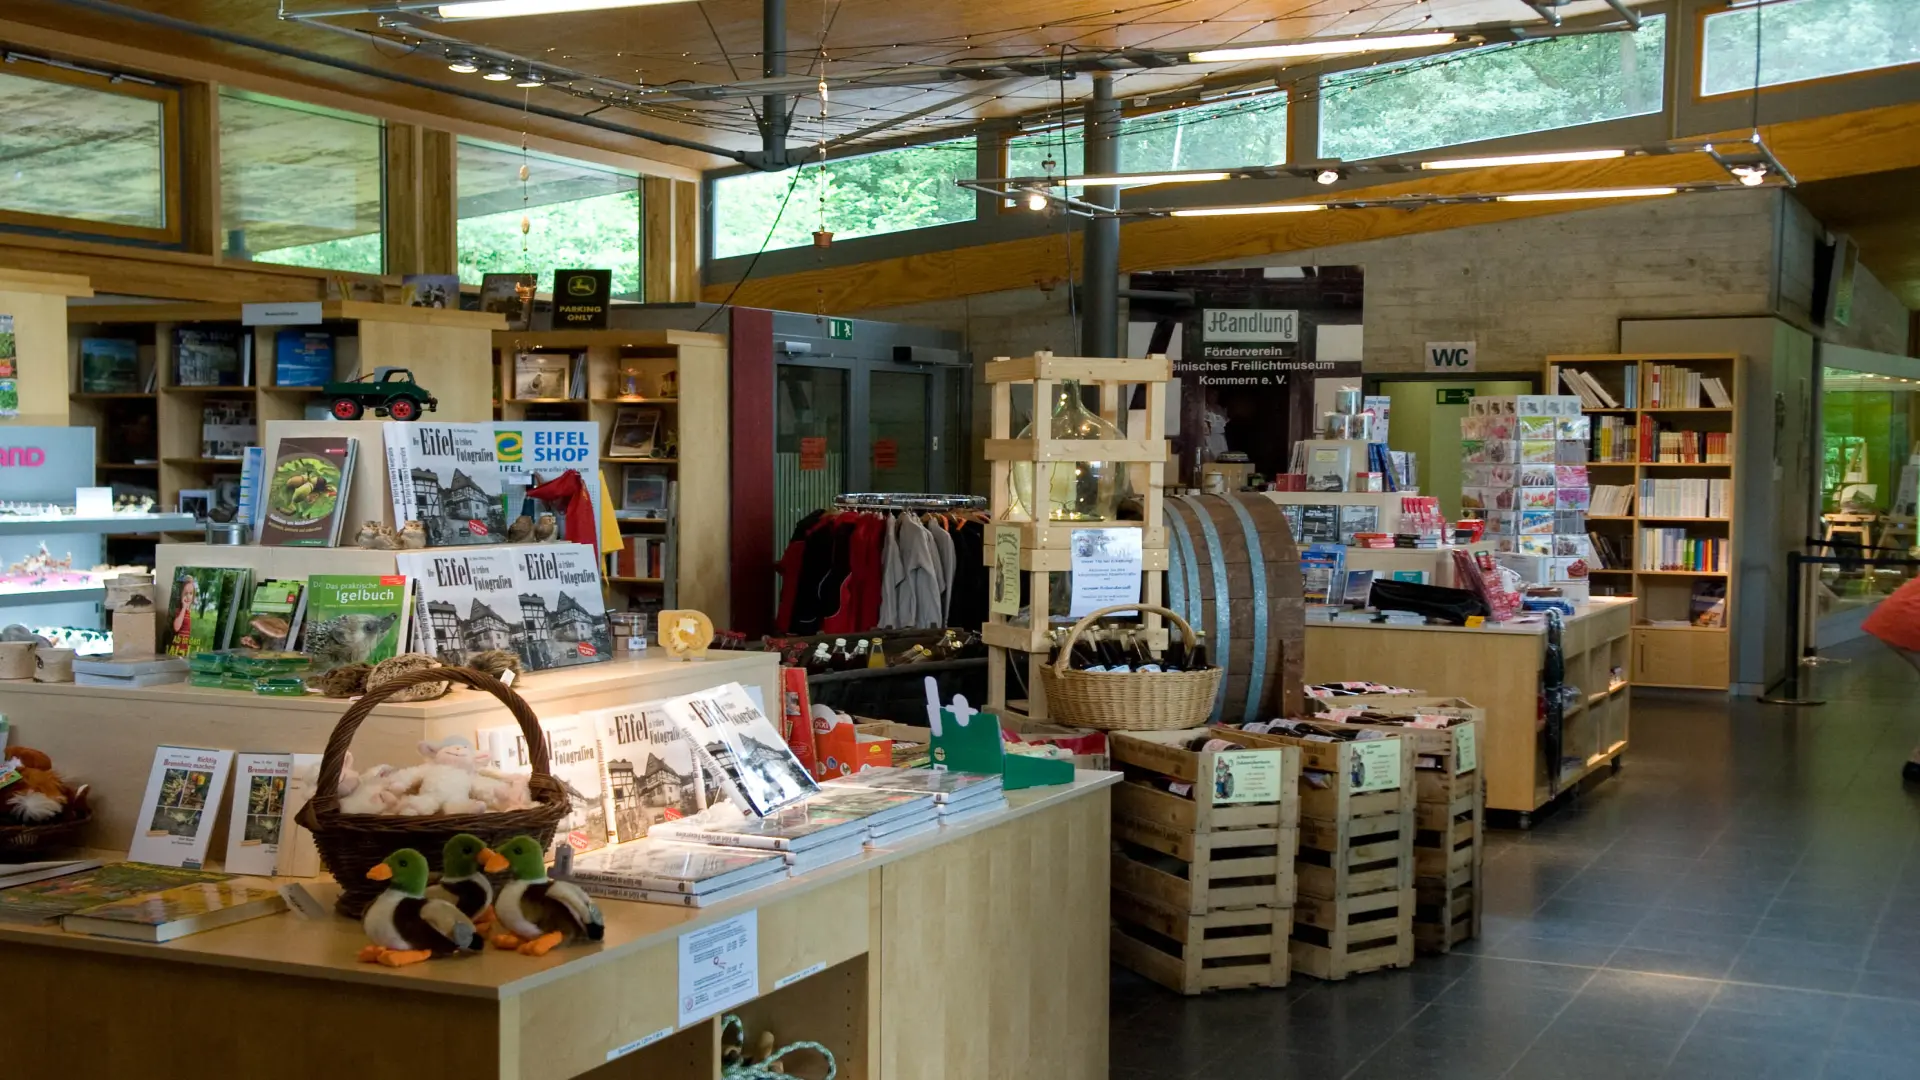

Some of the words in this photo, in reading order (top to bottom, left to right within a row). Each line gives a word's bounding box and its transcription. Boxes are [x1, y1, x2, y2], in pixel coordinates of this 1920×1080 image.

[558, 305, 602, 313] PARKING
[566, 314, 593, 322] ONLY
[1208, 311, 1293, 340] Handlung
[1204, 346, 1283, 357] Förderverein
[1432, 348, 1469, 367] WC
[1173, 361, 1228, 371] einisches
[1231, 361, 1335, 371] Freilichtmuseum
[1199, 376, 1258, 386] Kommern
[1261, 377, 1272, 385] e.
[1276, 375, 1288, 385] V.
[419, 427, 455, 457] Eifel
[534, 431, 590, 446] EIFEL
[456, 447, 495, 465] Fotografien
[534, 447, 590, 462] SHOP
[499, 465, 523, 473] IFEL
[433, 556, 472, 587] Eifel
[524, 552, 559, 581] Eifel
[325, 583, 339, 591] Das
[339, 581, 378, 592] praktische
[473, 576, 513, 592] Fotografien
[560, 571, 596, 587] Fotografien
[335, 588, 395, 605] Igelbuch
[688, 698, 730, 728] Eifel
[727, 706, 763, 726] Fotografien
[614, 711, 649, 745] Eifel
[814, 719, 830, 730] pixi
[650, 726, 682, 745] Fotografie
[554, 746, 595, 766] Fotografien
